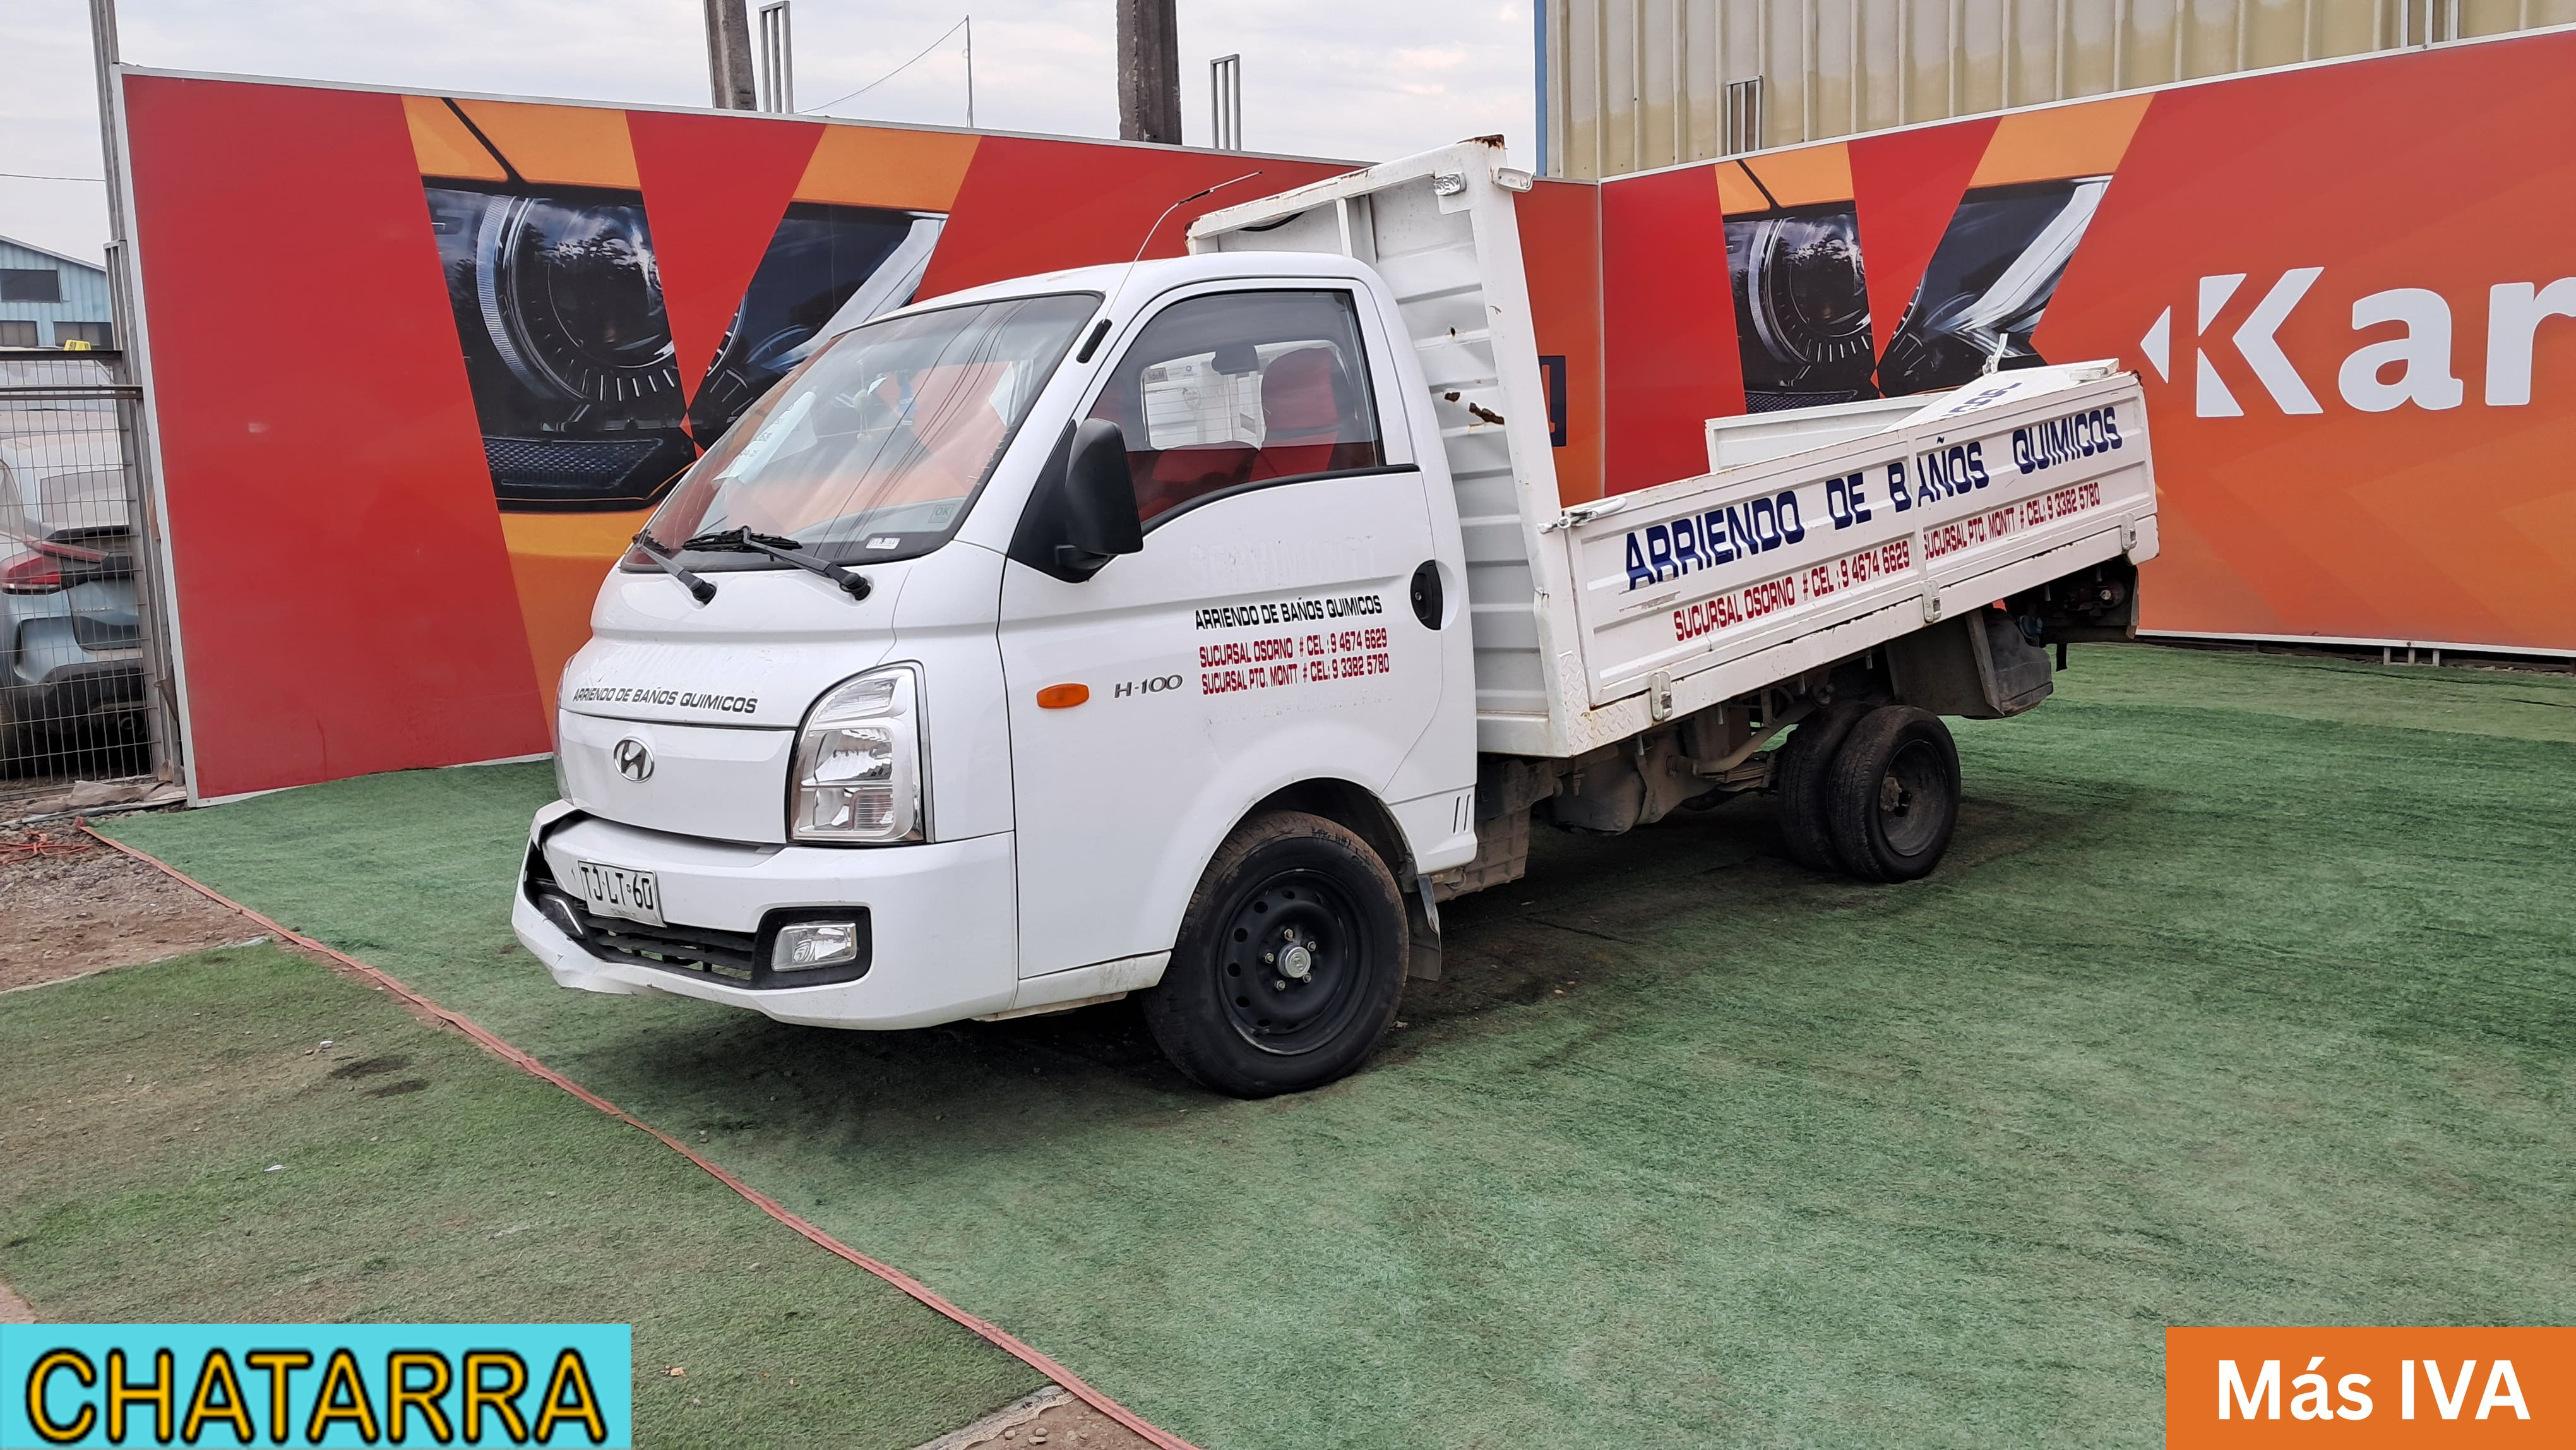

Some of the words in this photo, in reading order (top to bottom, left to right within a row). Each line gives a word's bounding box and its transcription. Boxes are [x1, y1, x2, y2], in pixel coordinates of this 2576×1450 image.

[934, 505, 951, 517] OK
[1626, 489, 1806, 591] ARRIENDO
[1825, 472, 1872, 530] DE
[1887, 436, 1989, 513] BAÑOS
[2012, 406, 2123, 475] QUIMICOS
[1923, 522, 1967, 561] SUCURSAL
[1968, 516, 1988, 546] PTO.
[1988, 506, 2015, 540] MONTT
[2027, 499, 2047, 526] CEL:
[2046, 495, 2054, 518] 9
[2054, 488, 2078, 517] 3382
[2078, 481, 2101, 509] 5780
[1673, 591, 1743, 642] SUCURSAL
[1744, 576, 1796, 620] OSORNO
[1851, 549, 1880, 584] 4674
[1881, 540, 1910, 574] 6629
[1195, 605, 1260, 630] ARRIENDO
[1260, 604, 1280, 625] DE
[1280, 596, 1325, 623] BAÑOS
[1326, 594, 1383, 618] QUIMICOS
[1199, 642, 1252, 668] SUCURSAL
[1253, 637, 1293, 662] OSORNO
[1339, 630, 1363, 652] 4674
[1364, 627, 1387, 650] 6629
[1114, 674, 1183, 699] H-100
[1202, 669, 1248, 695] SUCURSAL
[1248, 667, 1268, 690] PTO.
[1270, 663, 1297, 687] MONTT
[1310, 659, 1331, 682] CEL:
[1332, 658, 1339, 680] 9
[1340, 656, 1364, 678] 3382
[1366, 652, 1390, 675] 5780
[573, 687, 616, 702] ARRIENDO
[615, 687, 632, 702] DE
[631, 686, 679, 705] BAÑOS
[679, 692, 758, 714] QUIMICOS
